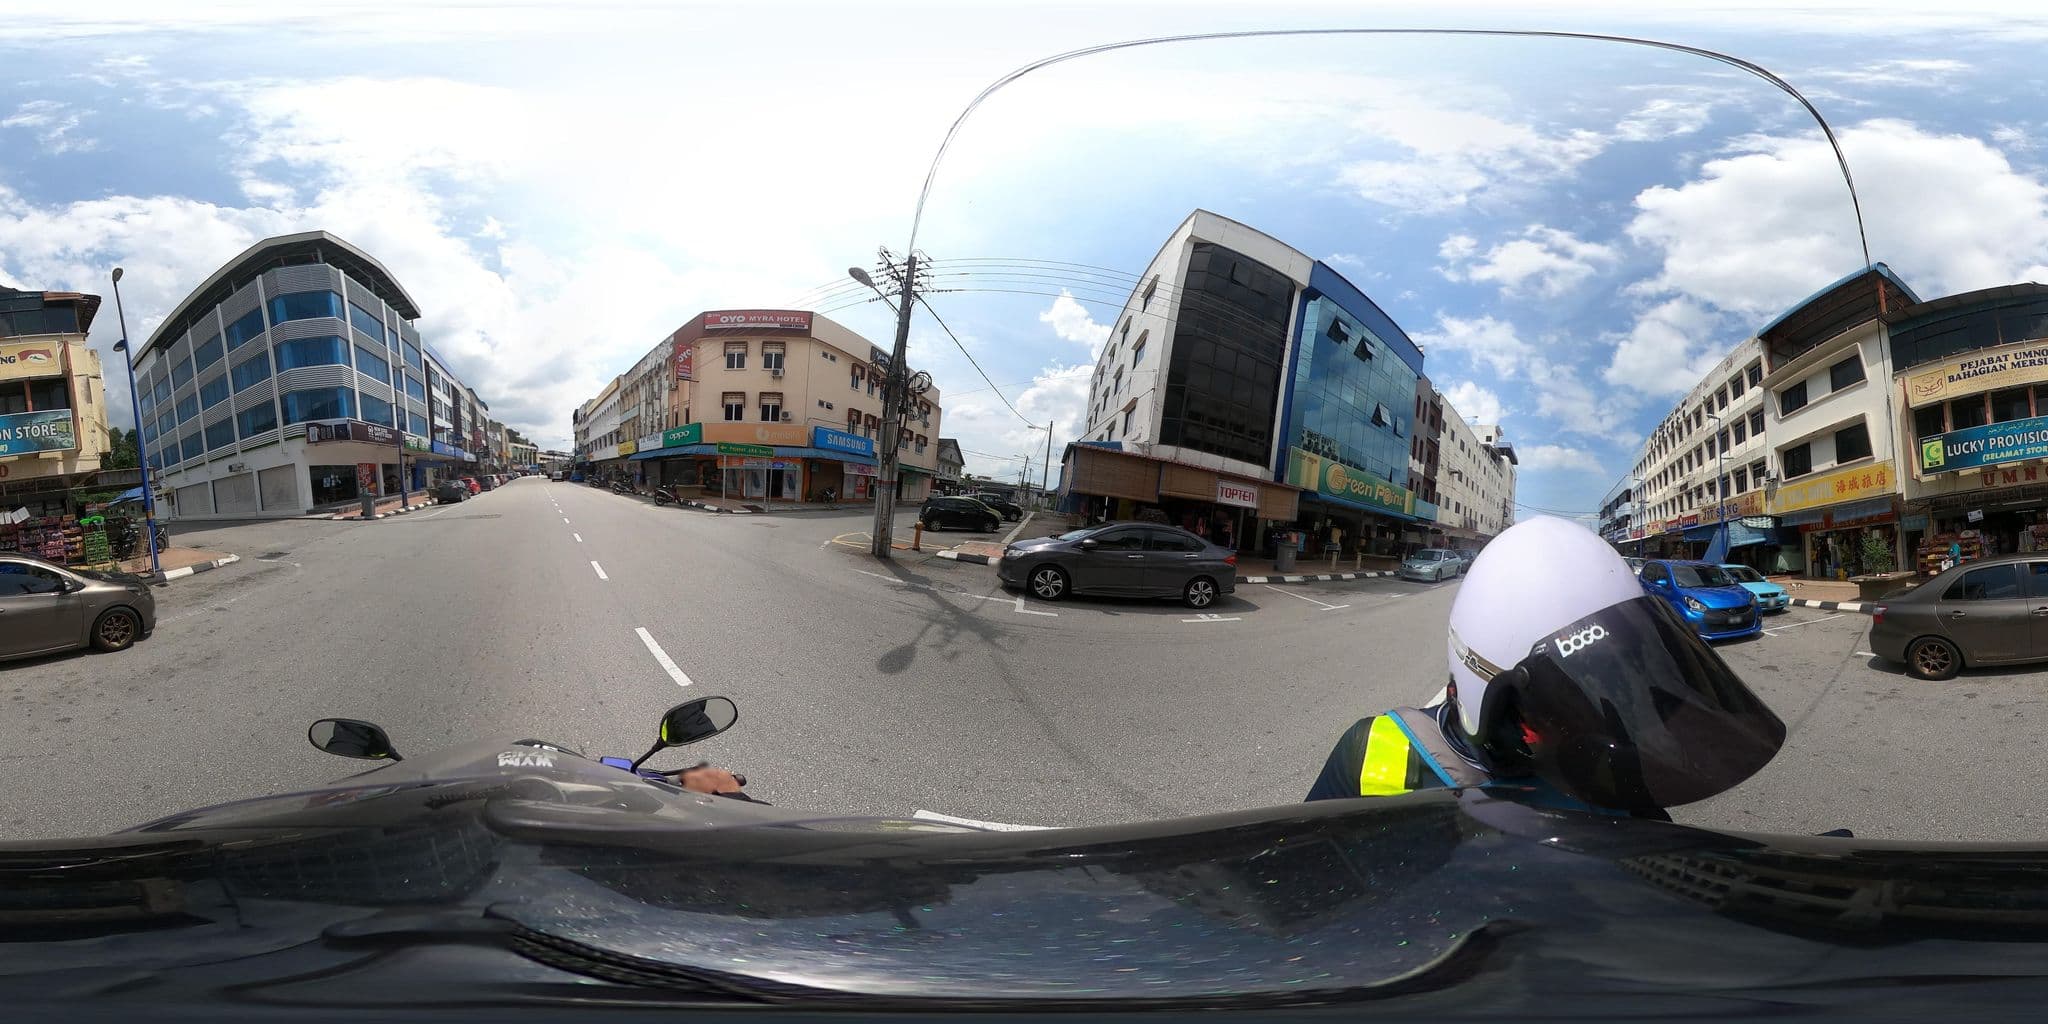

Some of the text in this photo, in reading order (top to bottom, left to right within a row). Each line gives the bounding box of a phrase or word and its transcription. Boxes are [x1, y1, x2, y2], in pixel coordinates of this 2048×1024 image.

[720, 315, 745, 324] OYO
[748, 315, 775, 323] MYRA
[1960, 354, 2010, 371] PEJABAT
[1948, 362, 2007, 384] BAHAGIAN
[16, 423, 57, 439] STORE
[827, 433, 866, 451] SAMSUNG
[1947, 439, 1985, 457] LUCKY
[1982, 448, 2024, 463] (SELAMAT
[1327, 463, 1373, 497] Green
